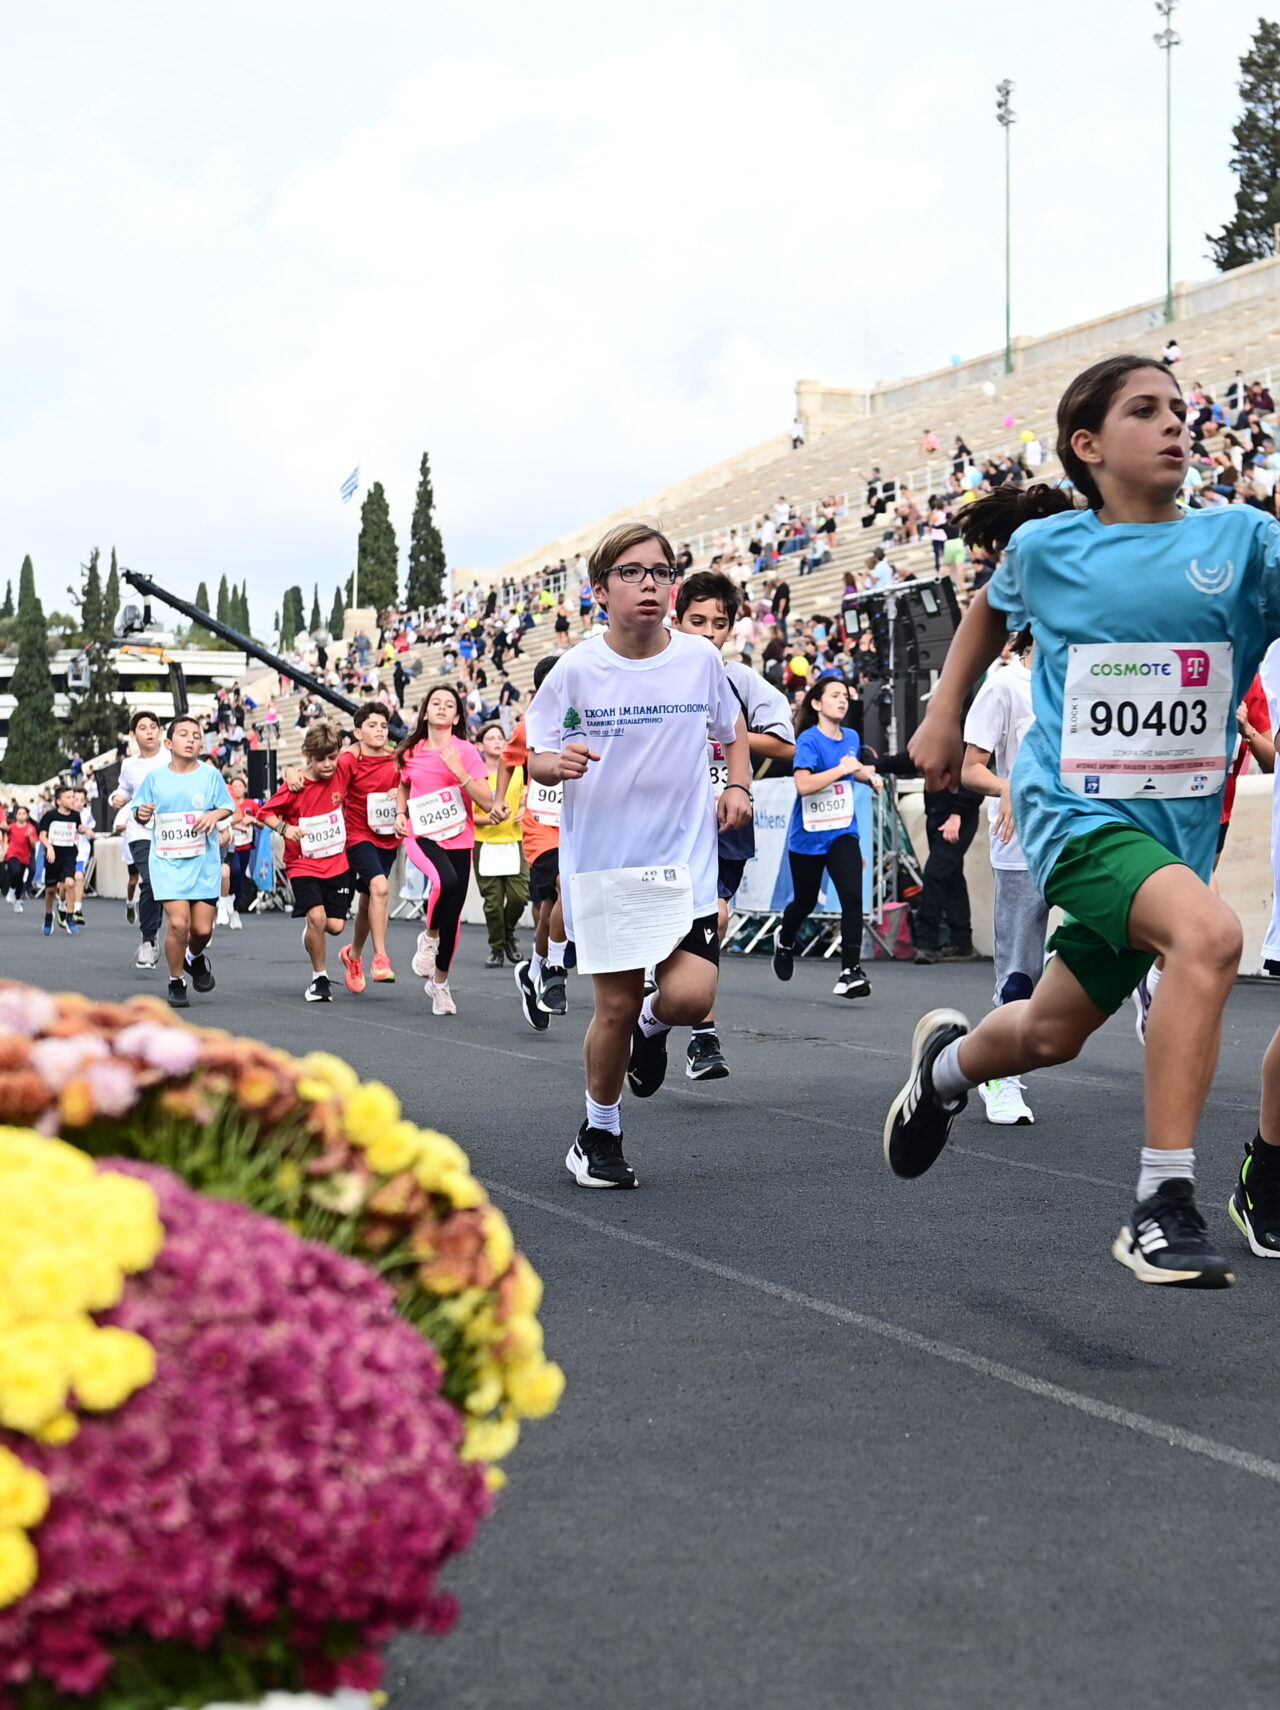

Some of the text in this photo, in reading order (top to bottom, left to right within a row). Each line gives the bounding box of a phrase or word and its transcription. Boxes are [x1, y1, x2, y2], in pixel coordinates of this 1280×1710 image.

[1090, 663, 1171, 676] COSMOTE
[585, 708, 616, 718] ΣΧΟΛΗ
[1070, 702, 1078, 733] BLOCK
[1090, 700, 1207, 737] 90403
[538, 789, 563, 804] 902
[375, 807, 397, 819] 903
[810, 798, 846, 813] 90507
[419, 804, 458, 826] 92495
[755, 809, 786, 830] Athens
[161, 828, 198, 841] 90346
[308, 826, 341, 844] 90324
